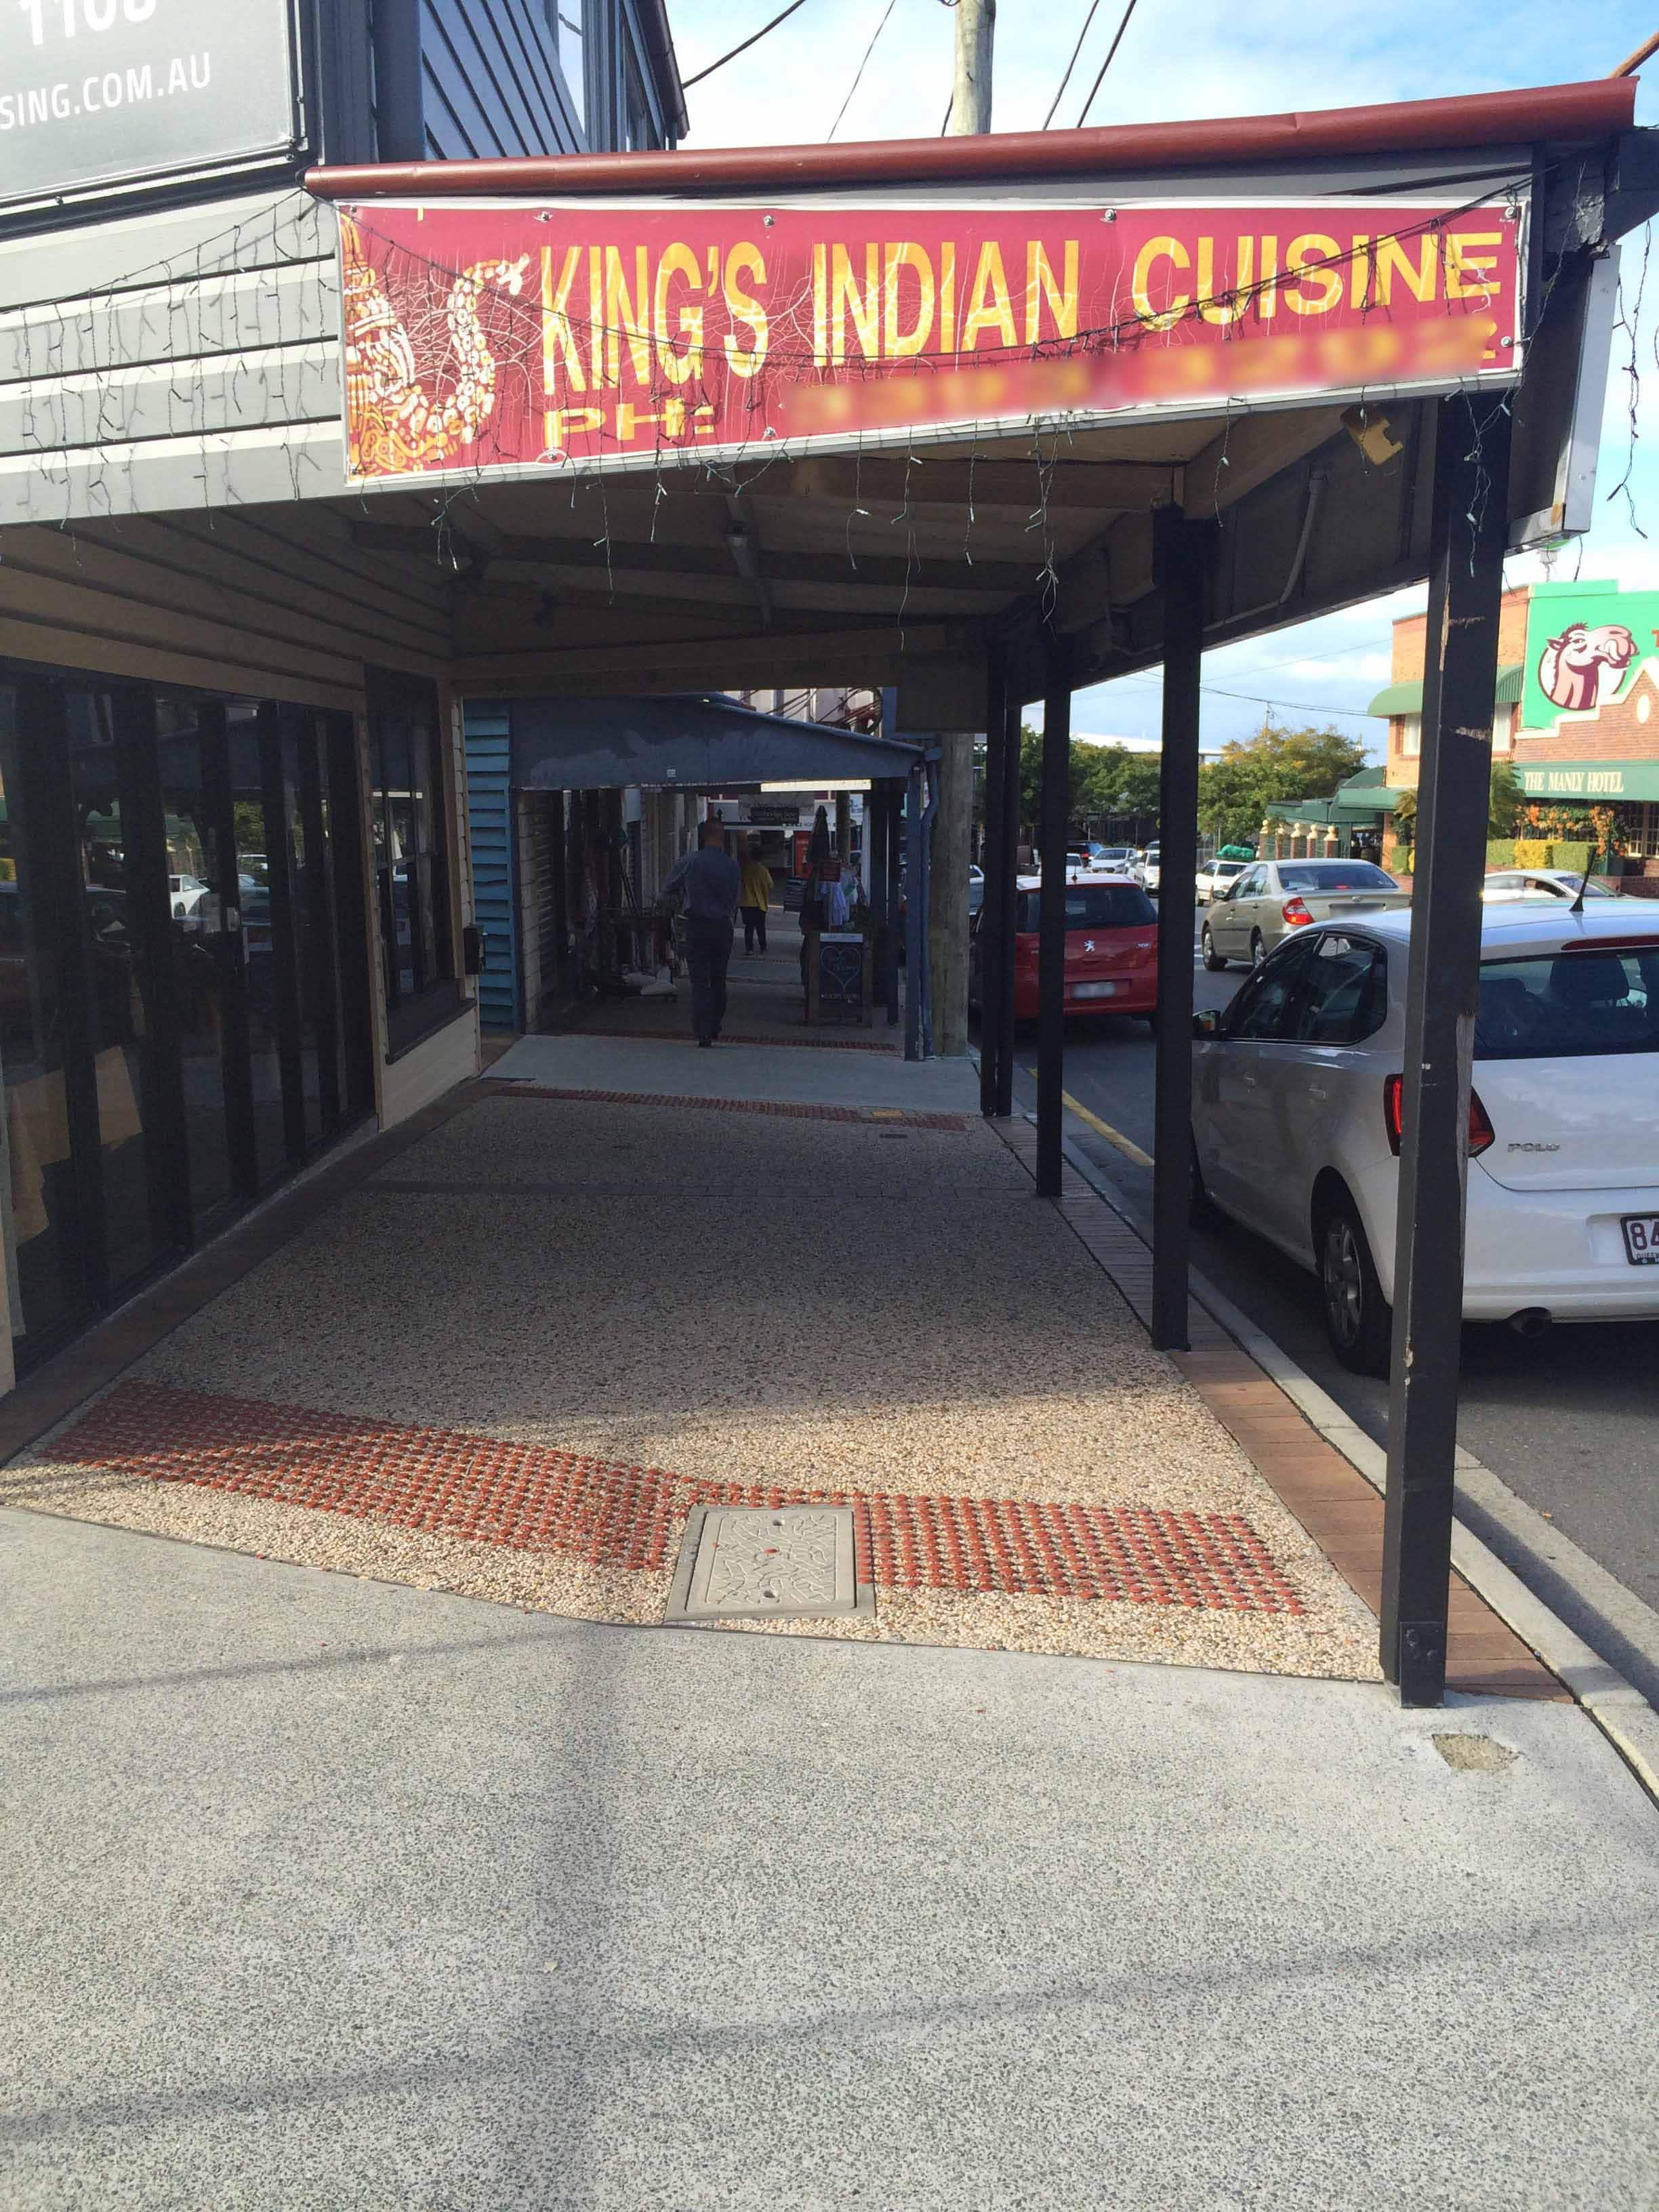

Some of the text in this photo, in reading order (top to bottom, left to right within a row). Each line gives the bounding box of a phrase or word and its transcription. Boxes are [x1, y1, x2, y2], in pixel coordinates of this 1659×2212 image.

[541, 241, 769, 396] KING'S
[812, 239, 1080, 367] INDIAN
[1132, 232, 1503, 332] CUISINE
[1524, 771, 1624, 792] THE MANLY HOTEL
[1507, 1143, 1560, 1153] POLO
